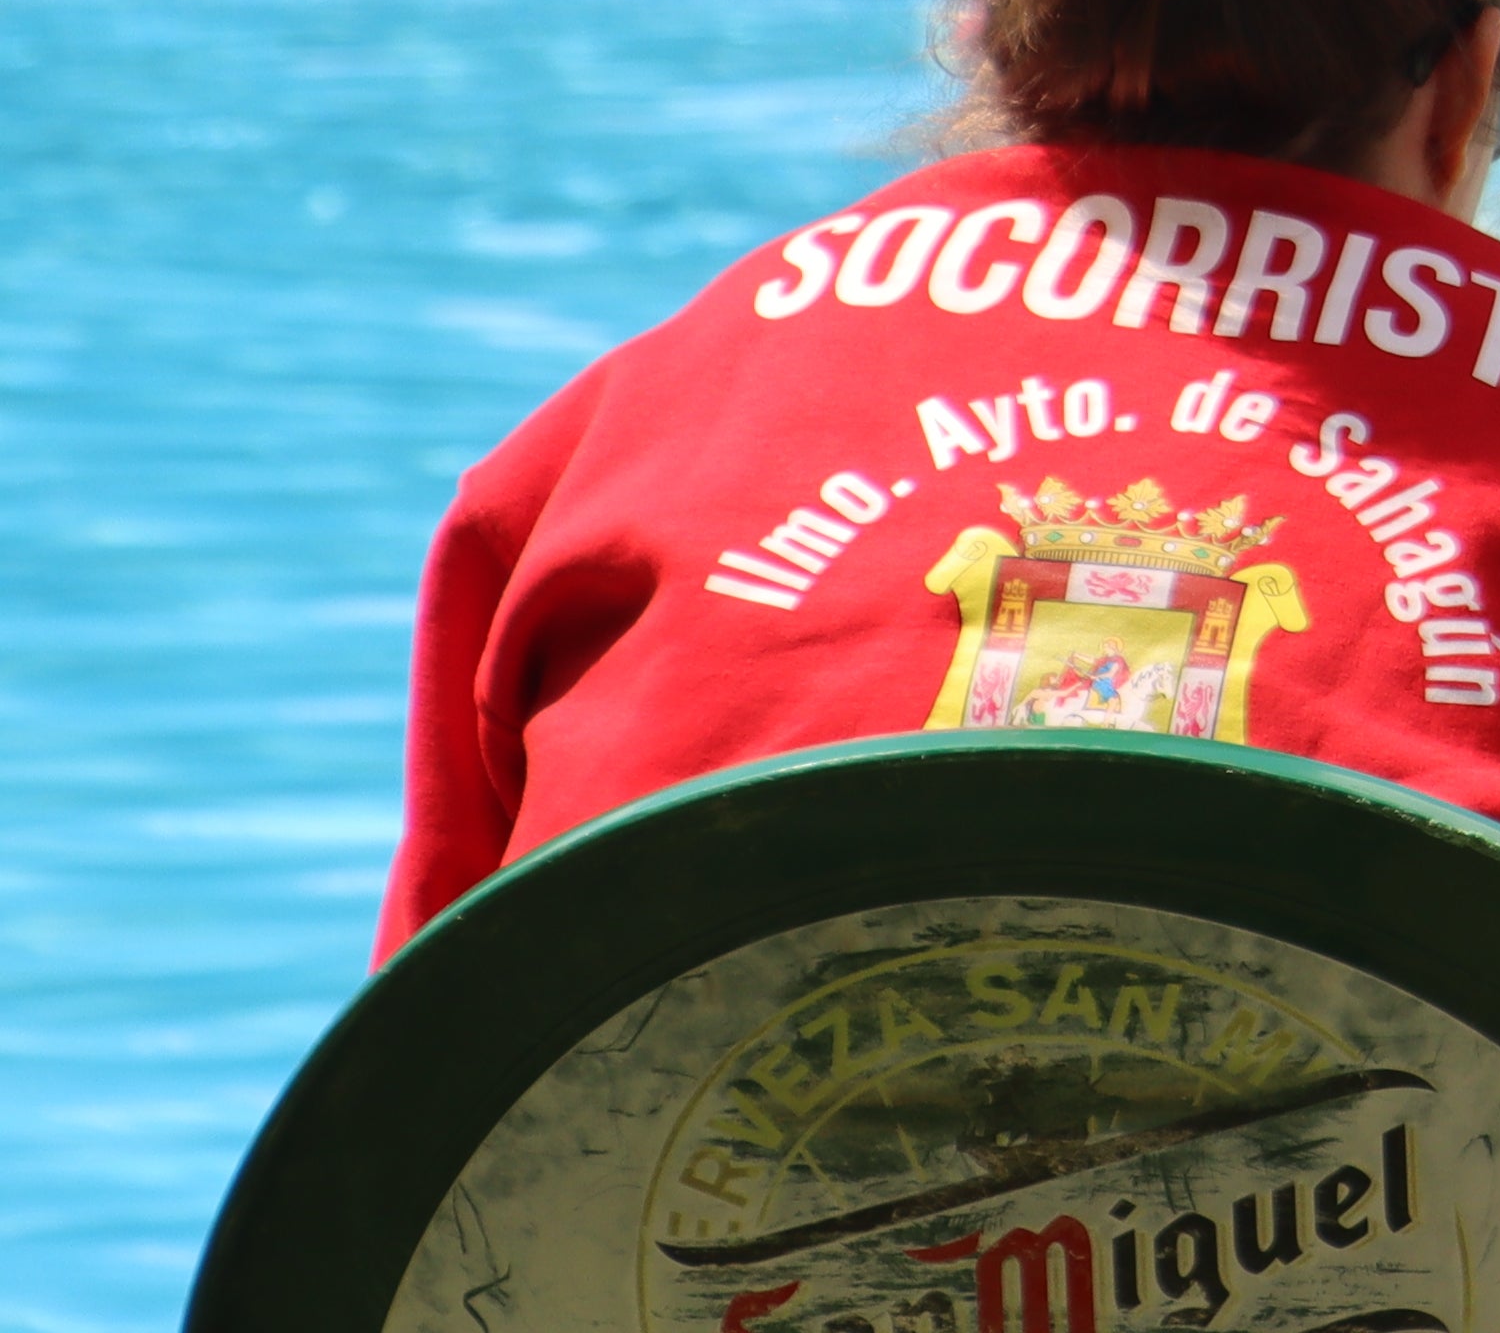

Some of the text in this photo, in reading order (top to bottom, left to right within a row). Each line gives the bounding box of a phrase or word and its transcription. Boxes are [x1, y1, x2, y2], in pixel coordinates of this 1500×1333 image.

[703, 469, 915, 609] Ilmo.
[916, 376, 1137, 470] Ayto.
[1171, 370, 1278, 443] de
[965, 963, 1181, 1043] SAN
[905, 1123, 1413, 1333] Miguel
